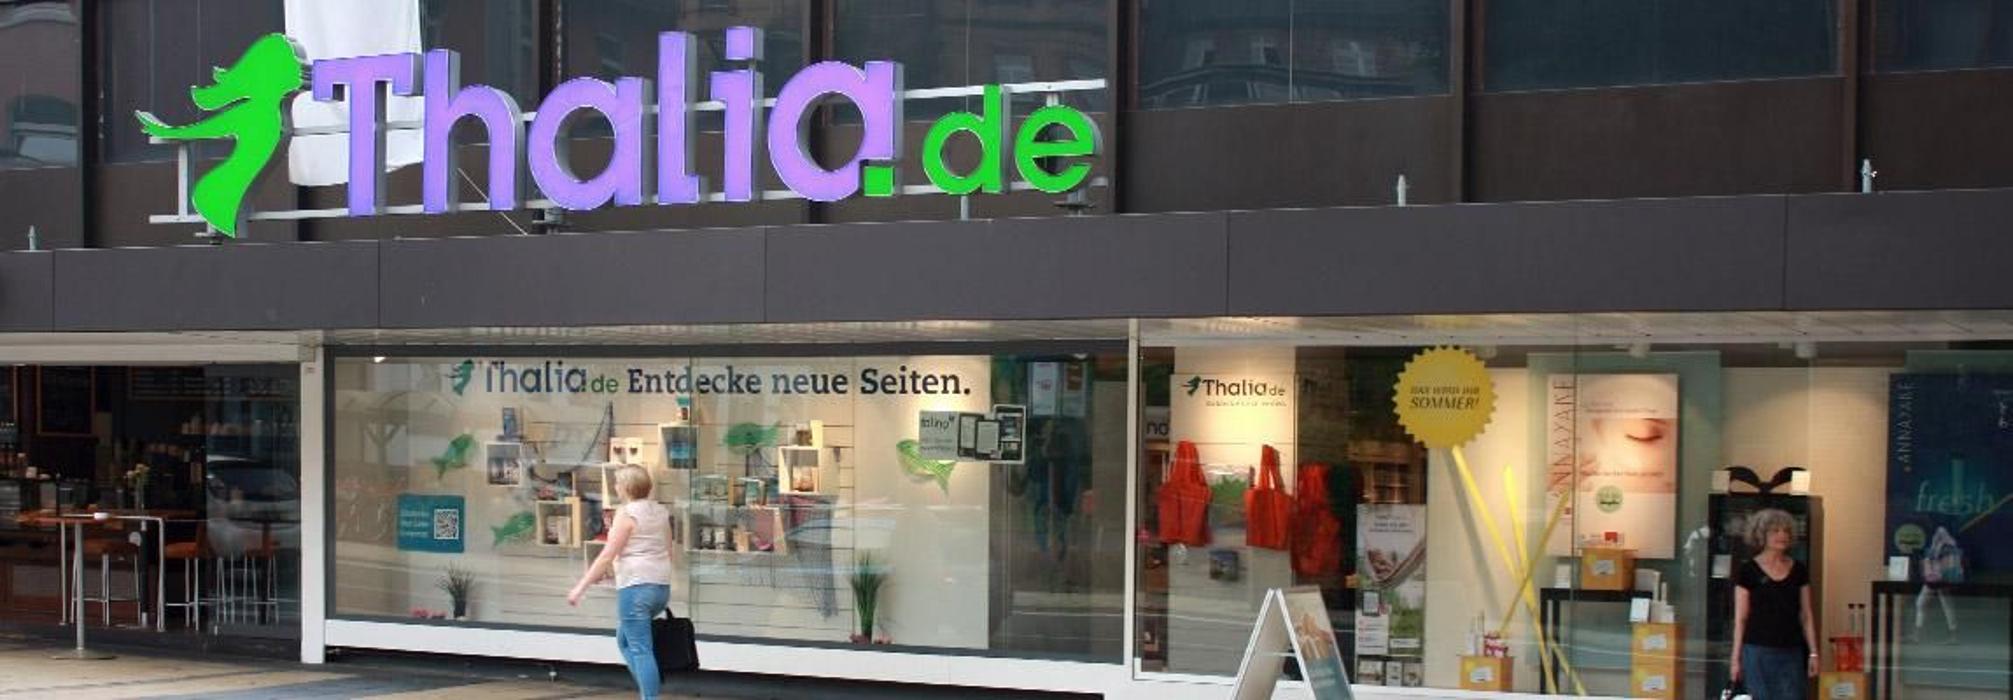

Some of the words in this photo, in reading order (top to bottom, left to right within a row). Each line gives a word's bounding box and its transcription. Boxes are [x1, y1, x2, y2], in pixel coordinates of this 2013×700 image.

[313, 26, 1098, 216] Thalia.de
[627, 366, 762, 394] Entdecke
[771, 373, 849, 394] neue
[860, 365, 972, 395] Seiten.
[1409, 396, 1480, 410] SOMMER!
